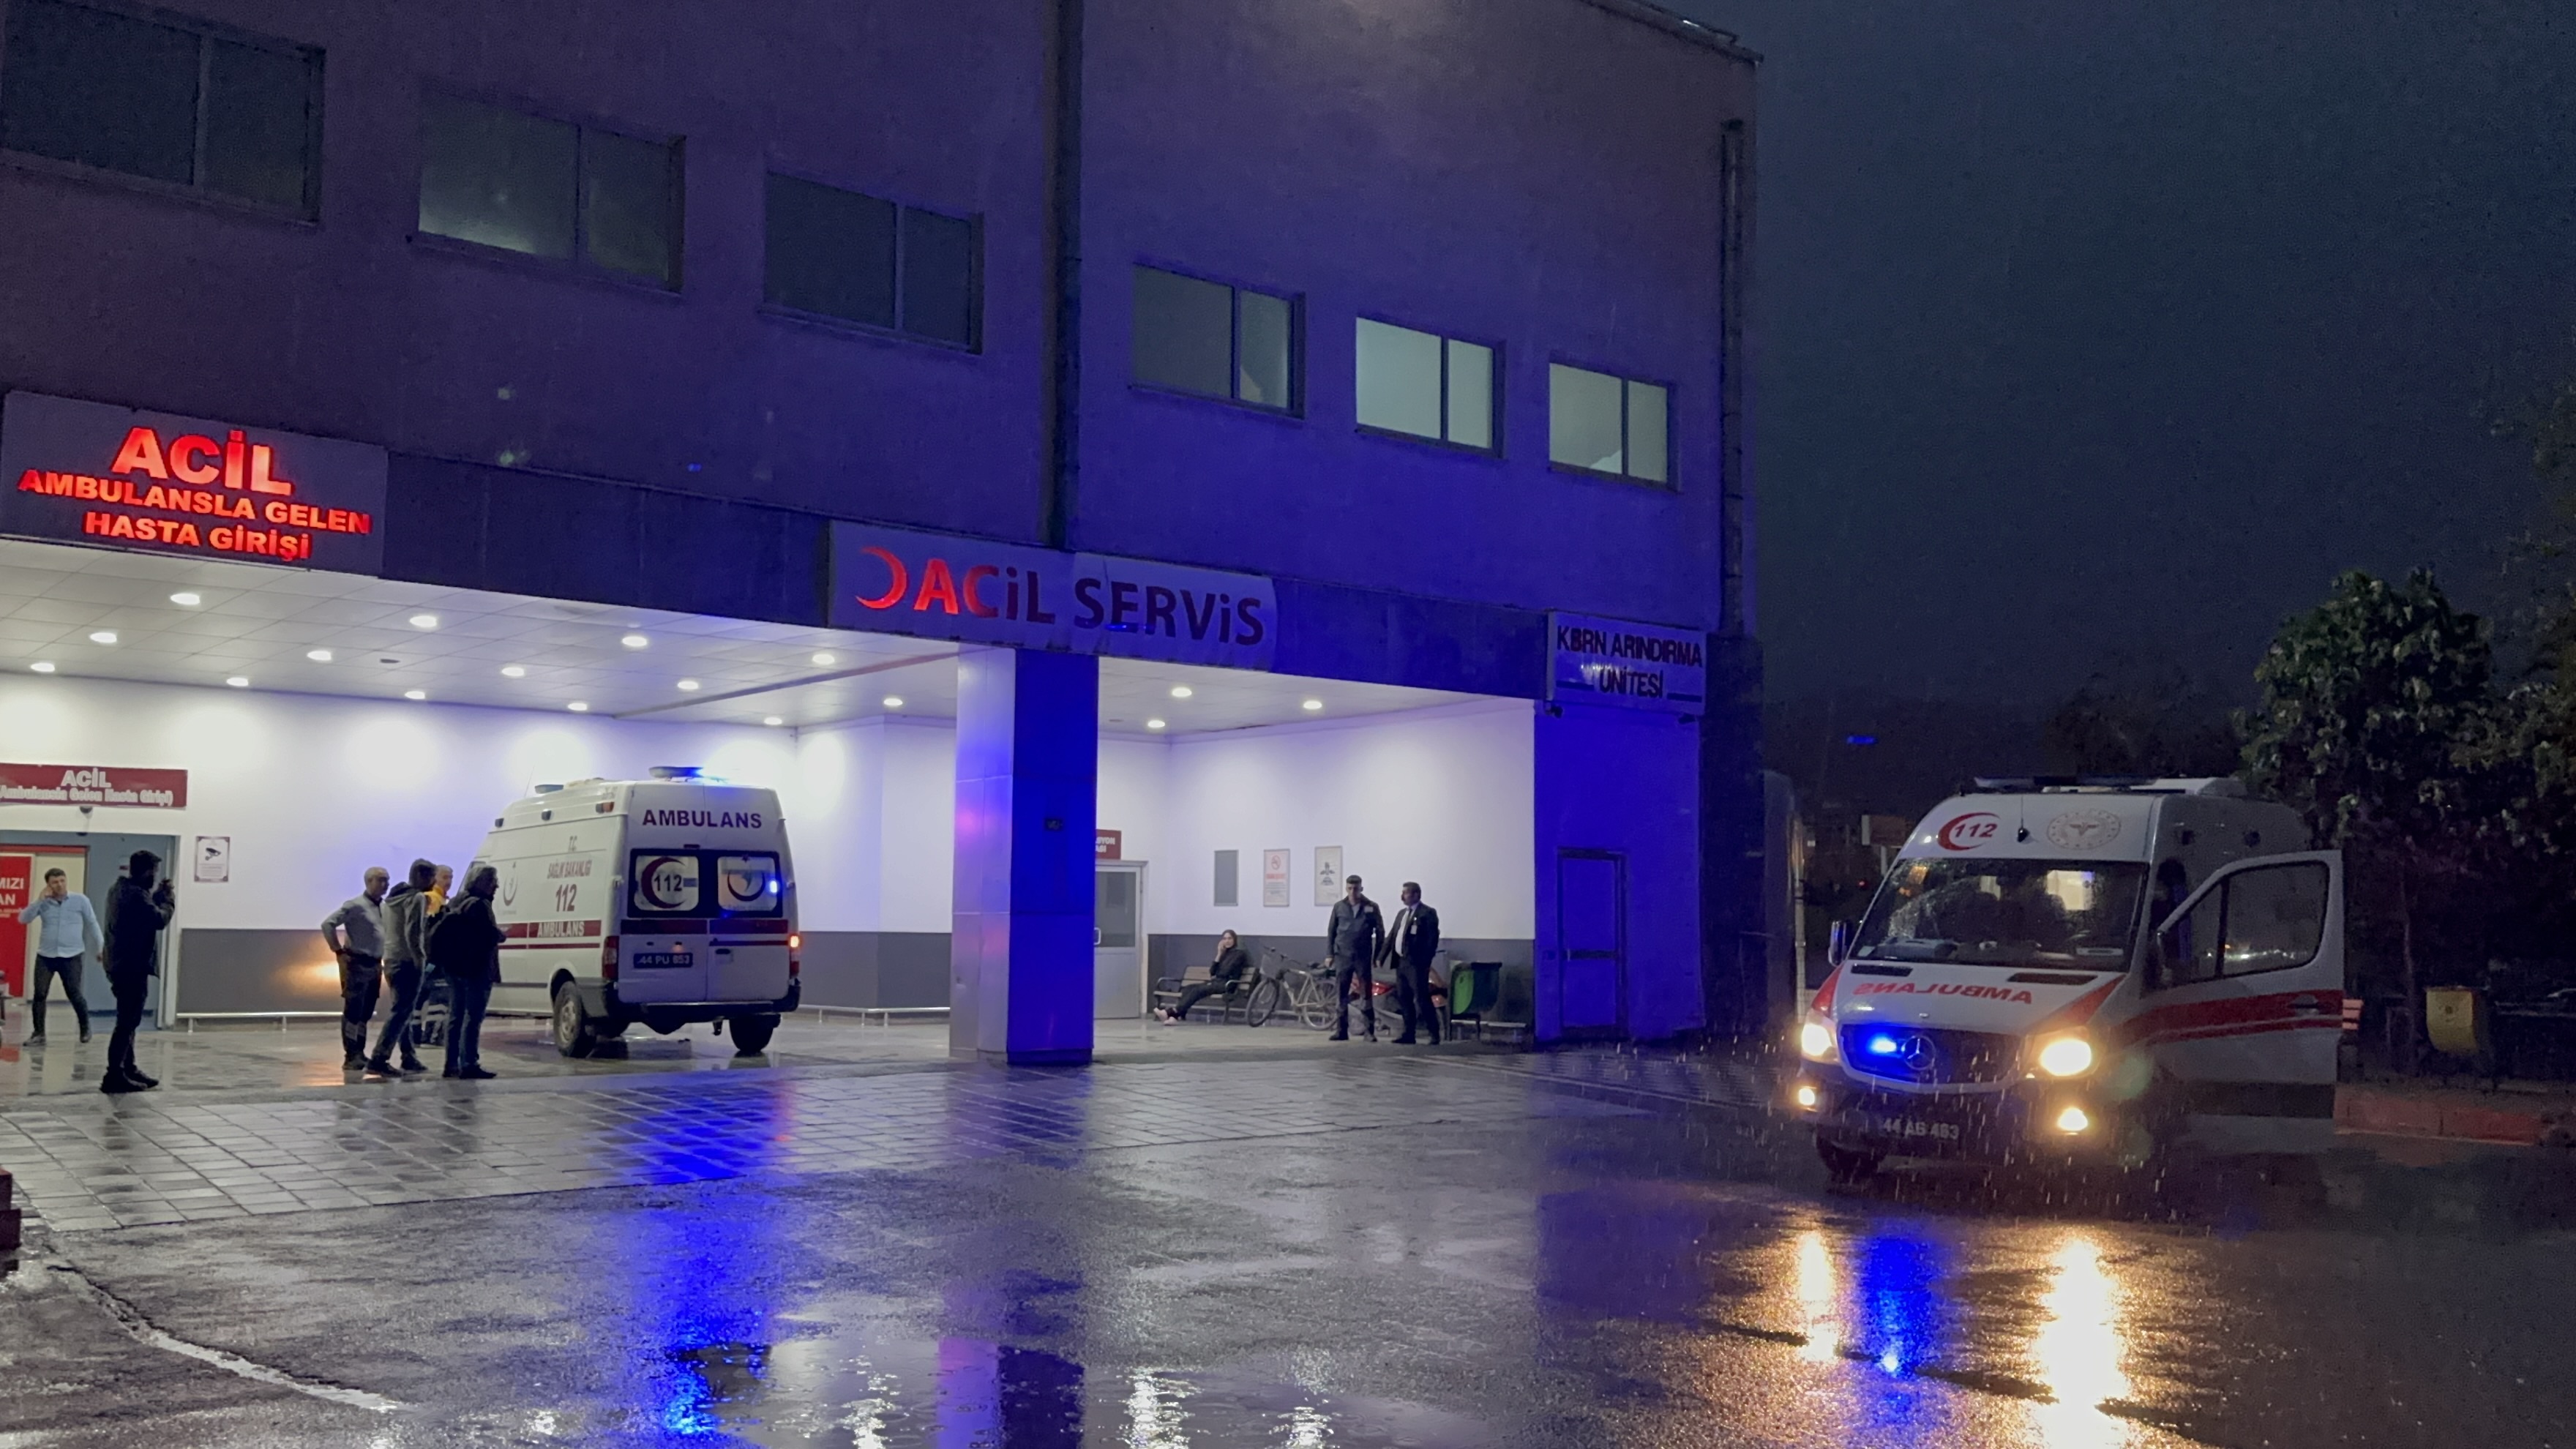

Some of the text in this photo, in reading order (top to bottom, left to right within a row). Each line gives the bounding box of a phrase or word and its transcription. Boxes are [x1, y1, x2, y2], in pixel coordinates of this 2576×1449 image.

[111, 427, 293, 495] ACİL
[18, 470, 372, 534] AMBULANSLA GELEN
[83, 512, 311, 561] HASTA GİRİŞİ
[1557, 626, 1702, 667] KBRN ARINDIRMA
[61, 768, 111, 787] ACİL
[643, 809, 762, 828] AMBULANS
[1955, 823, 1997, 838] 112
[654, 875, 682, 891] 112
[555, 884, 577, 912] 112
[537, 921, 585, 937] AMBULANS
